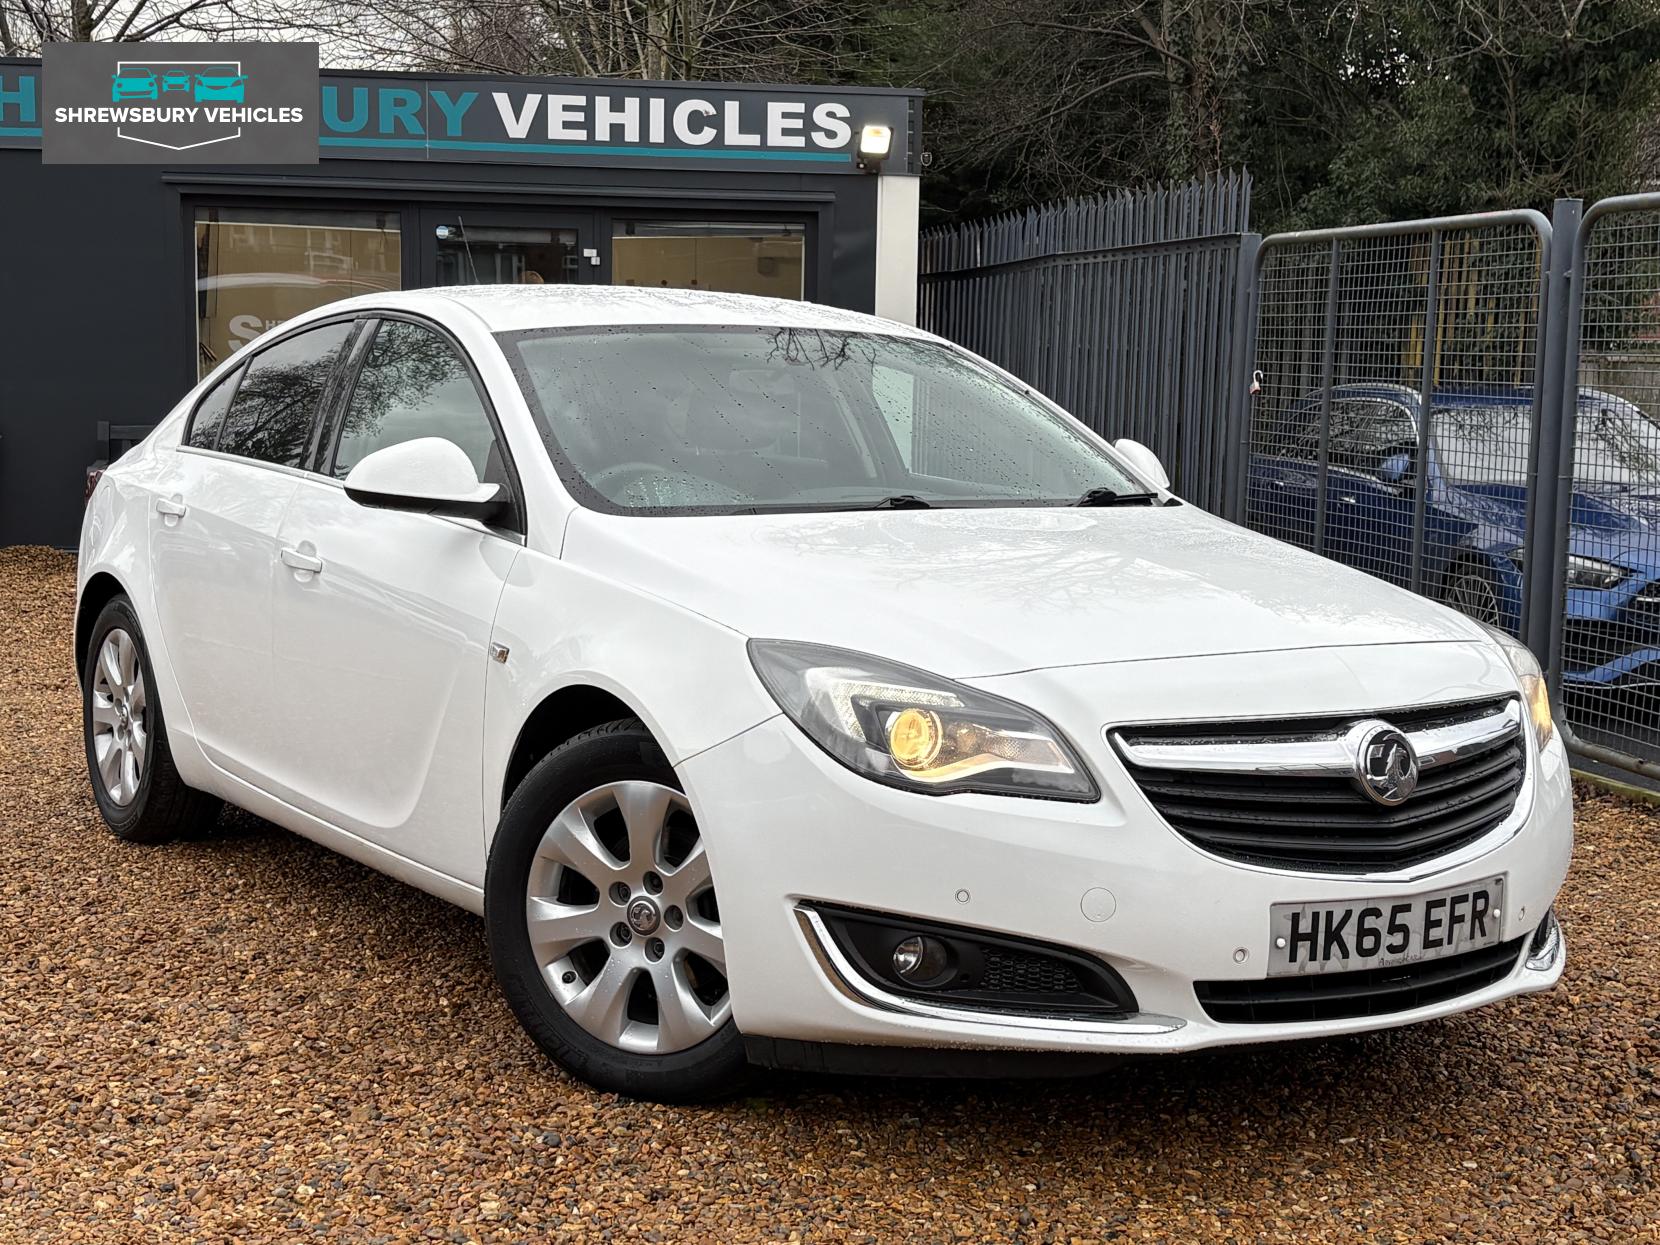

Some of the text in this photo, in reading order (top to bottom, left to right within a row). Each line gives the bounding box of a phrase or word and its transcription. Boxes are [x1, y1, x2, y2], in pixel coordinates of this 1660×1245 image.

[491, 92, 851, 148] VEHICLES
[1288, 889, 1490, 963] HK65 EFR
